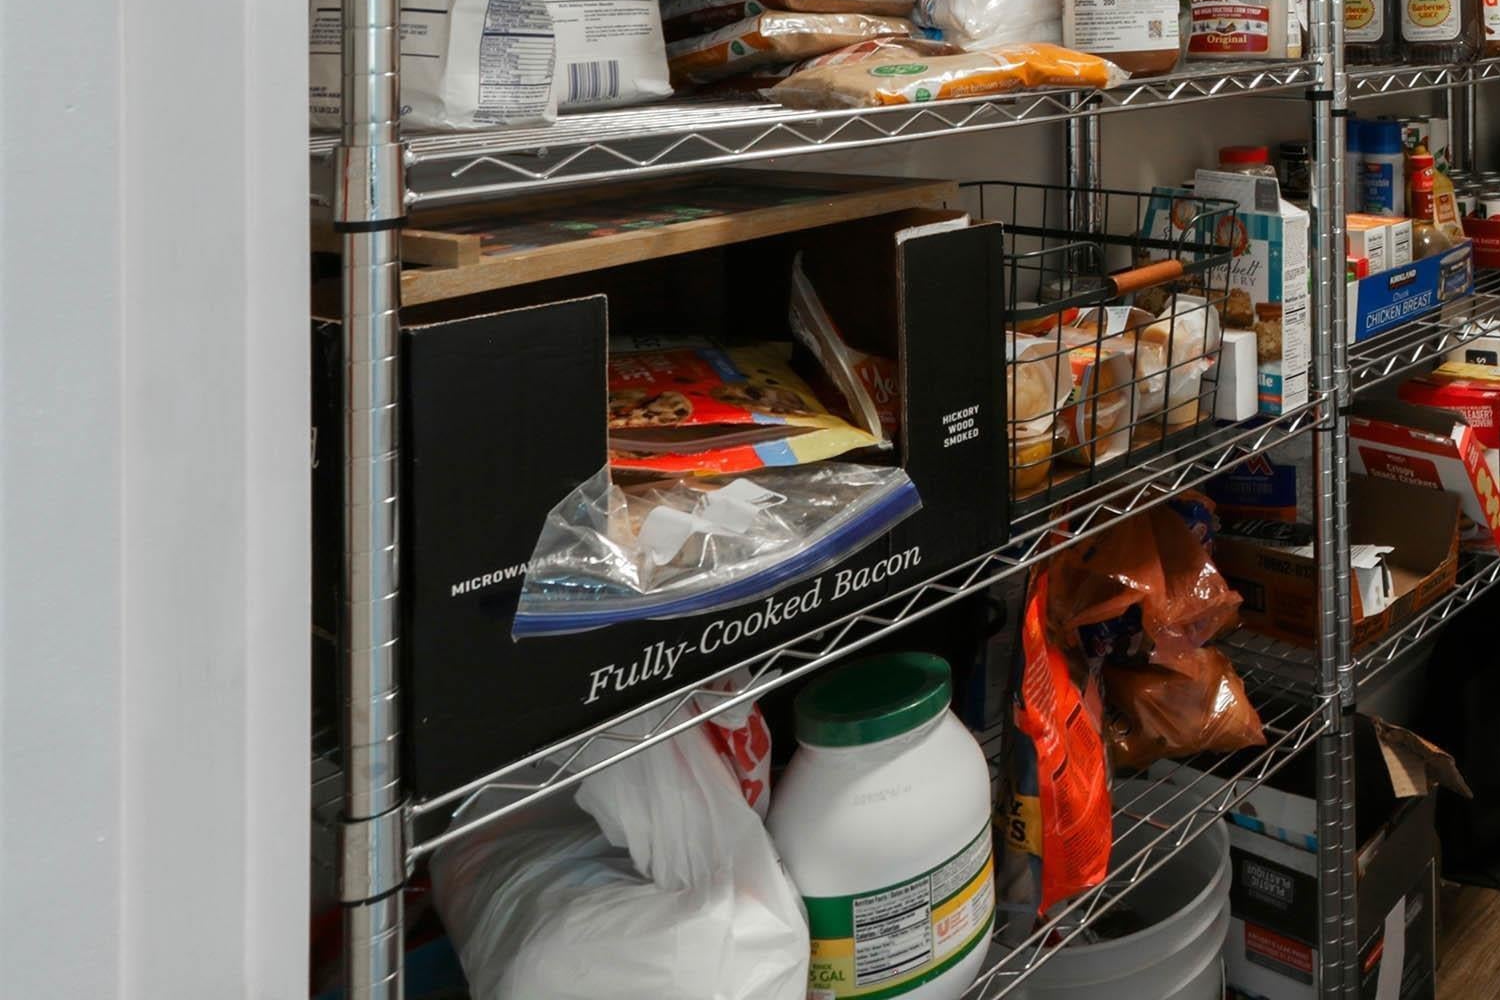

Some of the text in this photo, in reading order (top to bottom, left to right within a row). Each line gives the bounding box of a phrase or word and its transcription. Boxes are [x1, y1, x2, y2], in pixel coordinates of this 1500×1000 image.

[1206, 34, 1248, 45] Original
[1366, 292, 1432, 329] CHICKEN BREAST
[942, 404, 980, 425] HICKORY
[948, 417, 975, 435] WOOD
[943, 427, 980, 448] SMOKED
[584, 542, 923, 705] Fully-Cooked Bacon
[1251, 876, 1286, 897] PLASTIC
[819, 970, 846, 982] GAL
